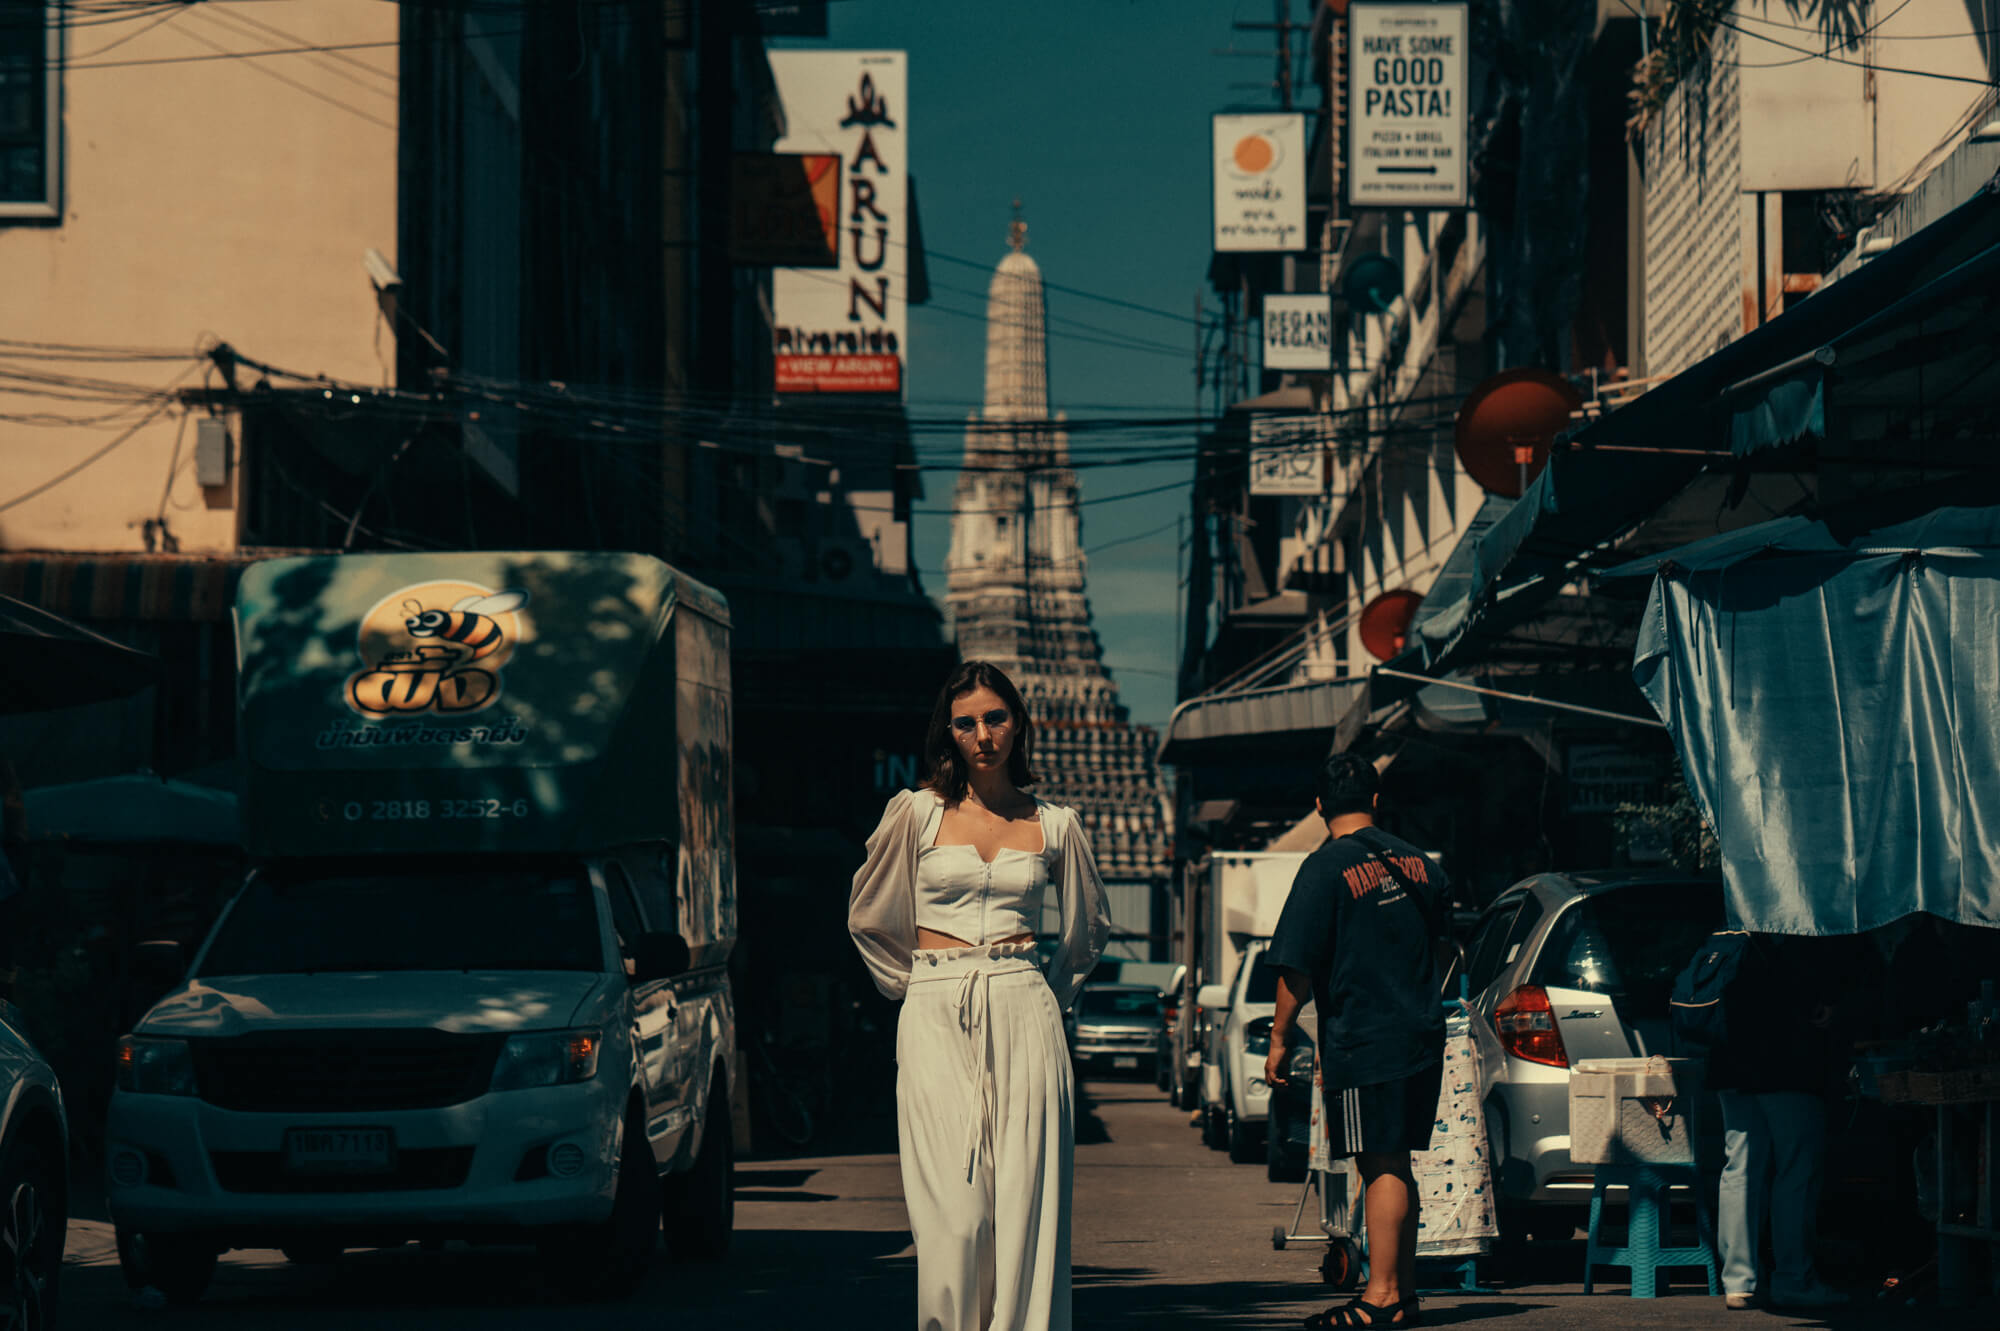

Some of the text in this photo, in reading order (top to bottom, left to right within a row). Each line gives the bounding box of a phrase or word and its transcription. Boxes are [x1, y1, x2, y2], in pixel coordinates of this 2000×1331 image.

[1363, 36, 1454, 54] HAVE SOME
[1374, 58, 1443, 85] GOOD
[1366, 89, 1451, 117] PASTA!
[1372, 132, 1402, 143] PIZZA
[1433, 148, 1452, 158] BAR
[849, 130, 889, 322] ARUN
[1268, 329, 1329, 346] VEGAN
[371, 799, 431, 821] 2818
[440, 798, 529, 819] 3252-6
